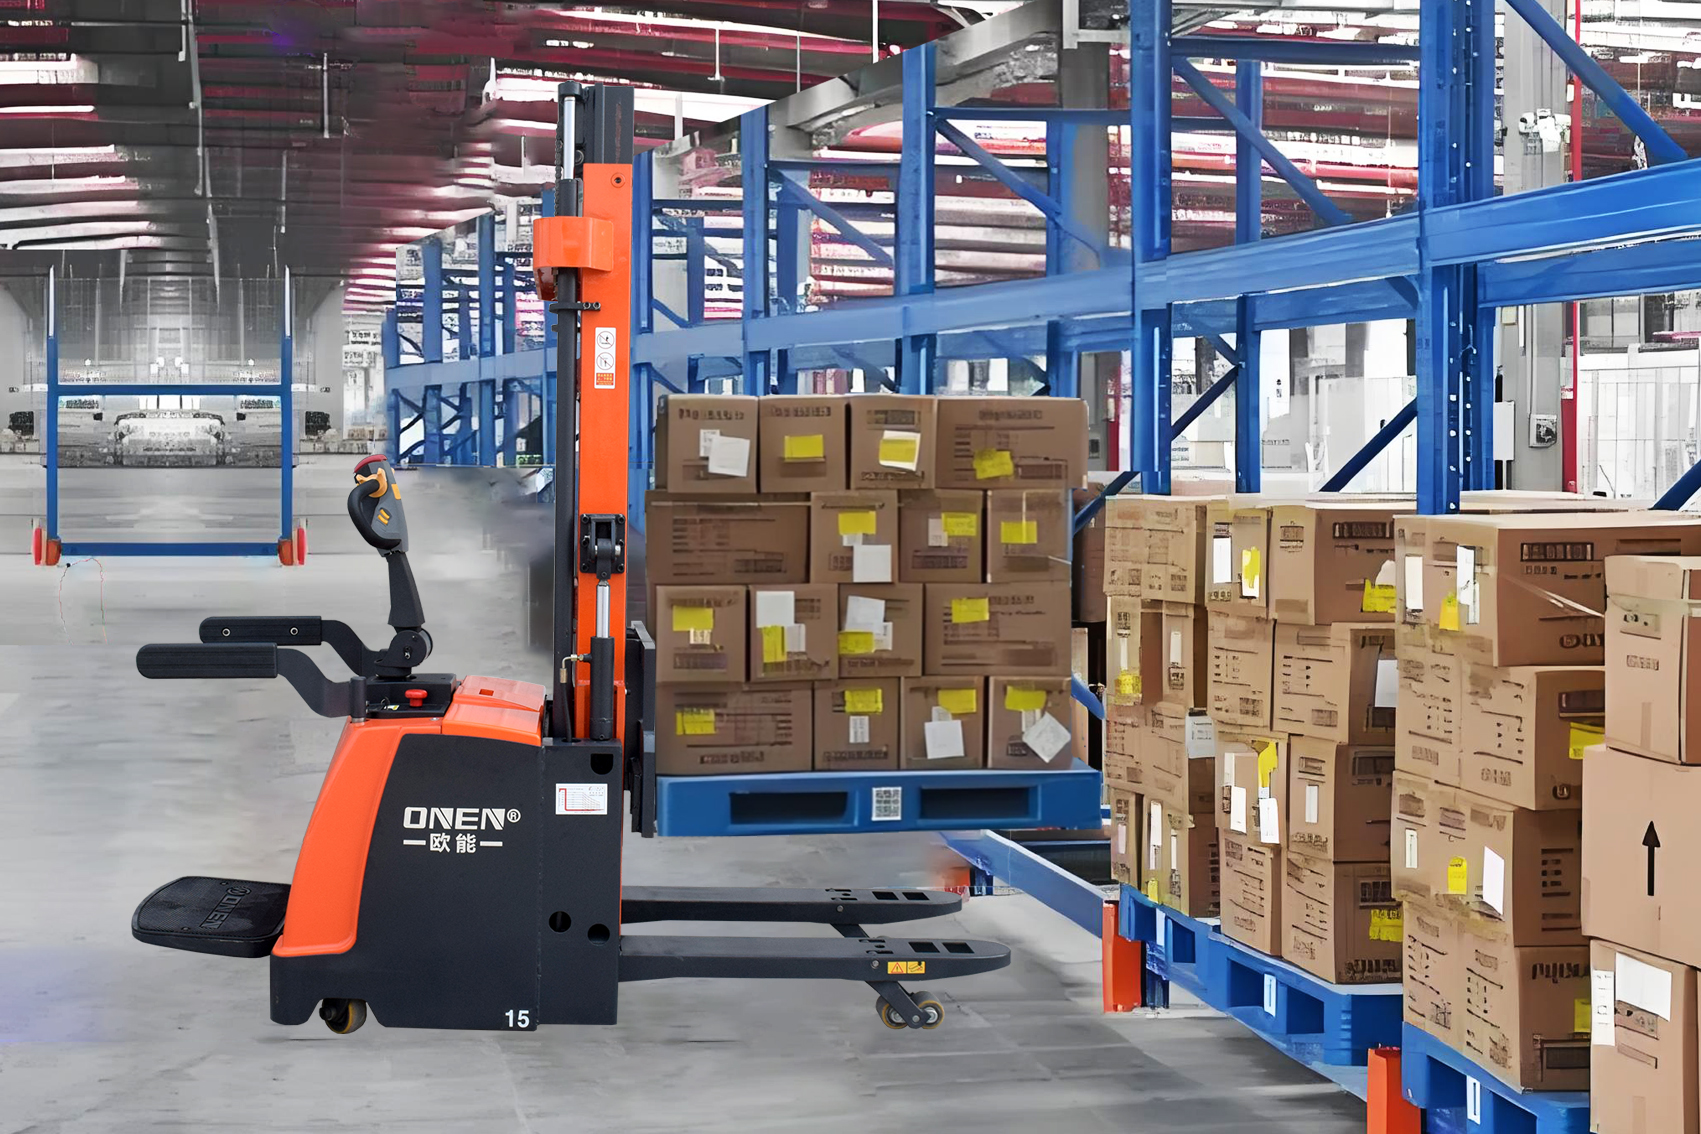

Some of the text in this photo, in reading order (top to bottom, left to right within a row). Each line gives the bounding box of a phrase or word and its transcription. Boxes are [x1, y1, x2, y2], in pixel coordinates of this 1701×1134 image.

[429, 832, 477, 854] 欧能
[200, 894, 242, 929] ONEN
[505, 1009, 530, 1028] 15
